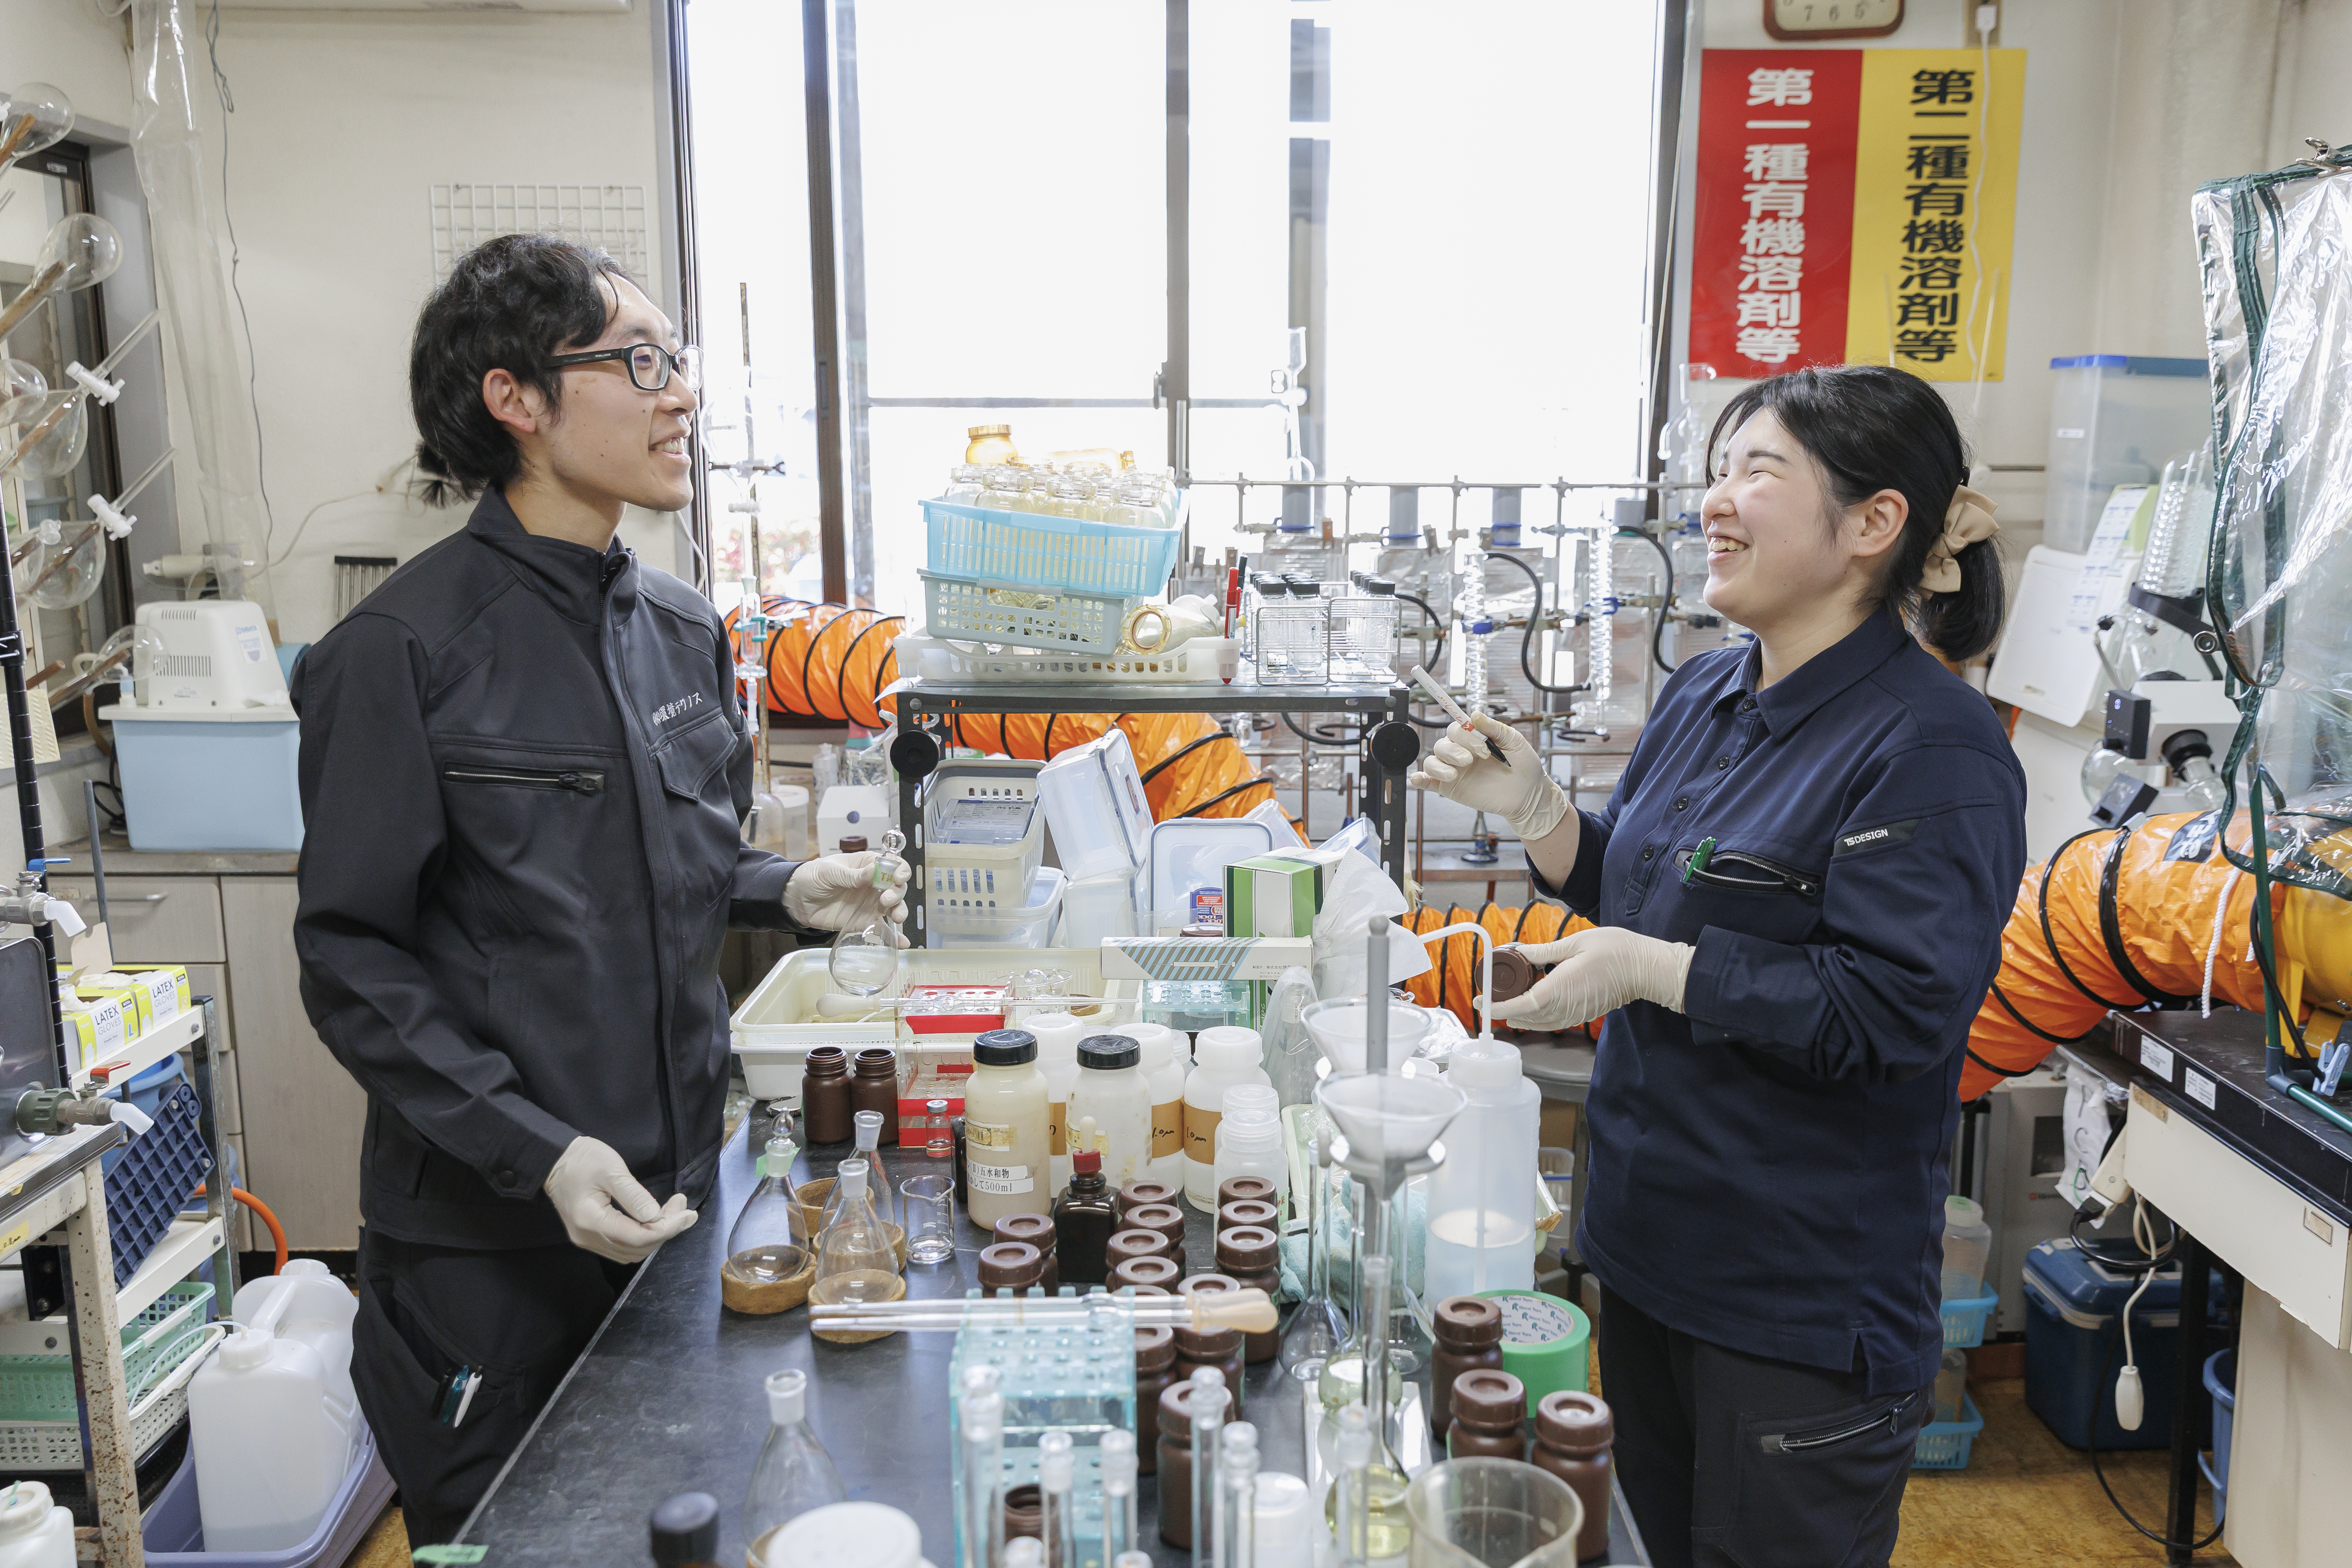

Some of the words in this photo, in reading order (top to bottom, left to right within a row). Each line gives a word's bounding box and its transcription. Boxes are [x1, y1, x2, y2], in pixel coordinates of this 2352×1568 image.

[1736, 67, 1814, 363] 第一種有機溶剤等
[1895, 69, 1975, 363] 第二種有機溶剤等
[152, 979, 174, 998] LATEX
[154, 991, 176, 1007] GLOVES
[181, 997, 187, 1010] S
[95, 1005, 119, 1025] LATEX
[98, 1017, 121, 1035] GLOVES
[128, 1024, 134, 1037] L
